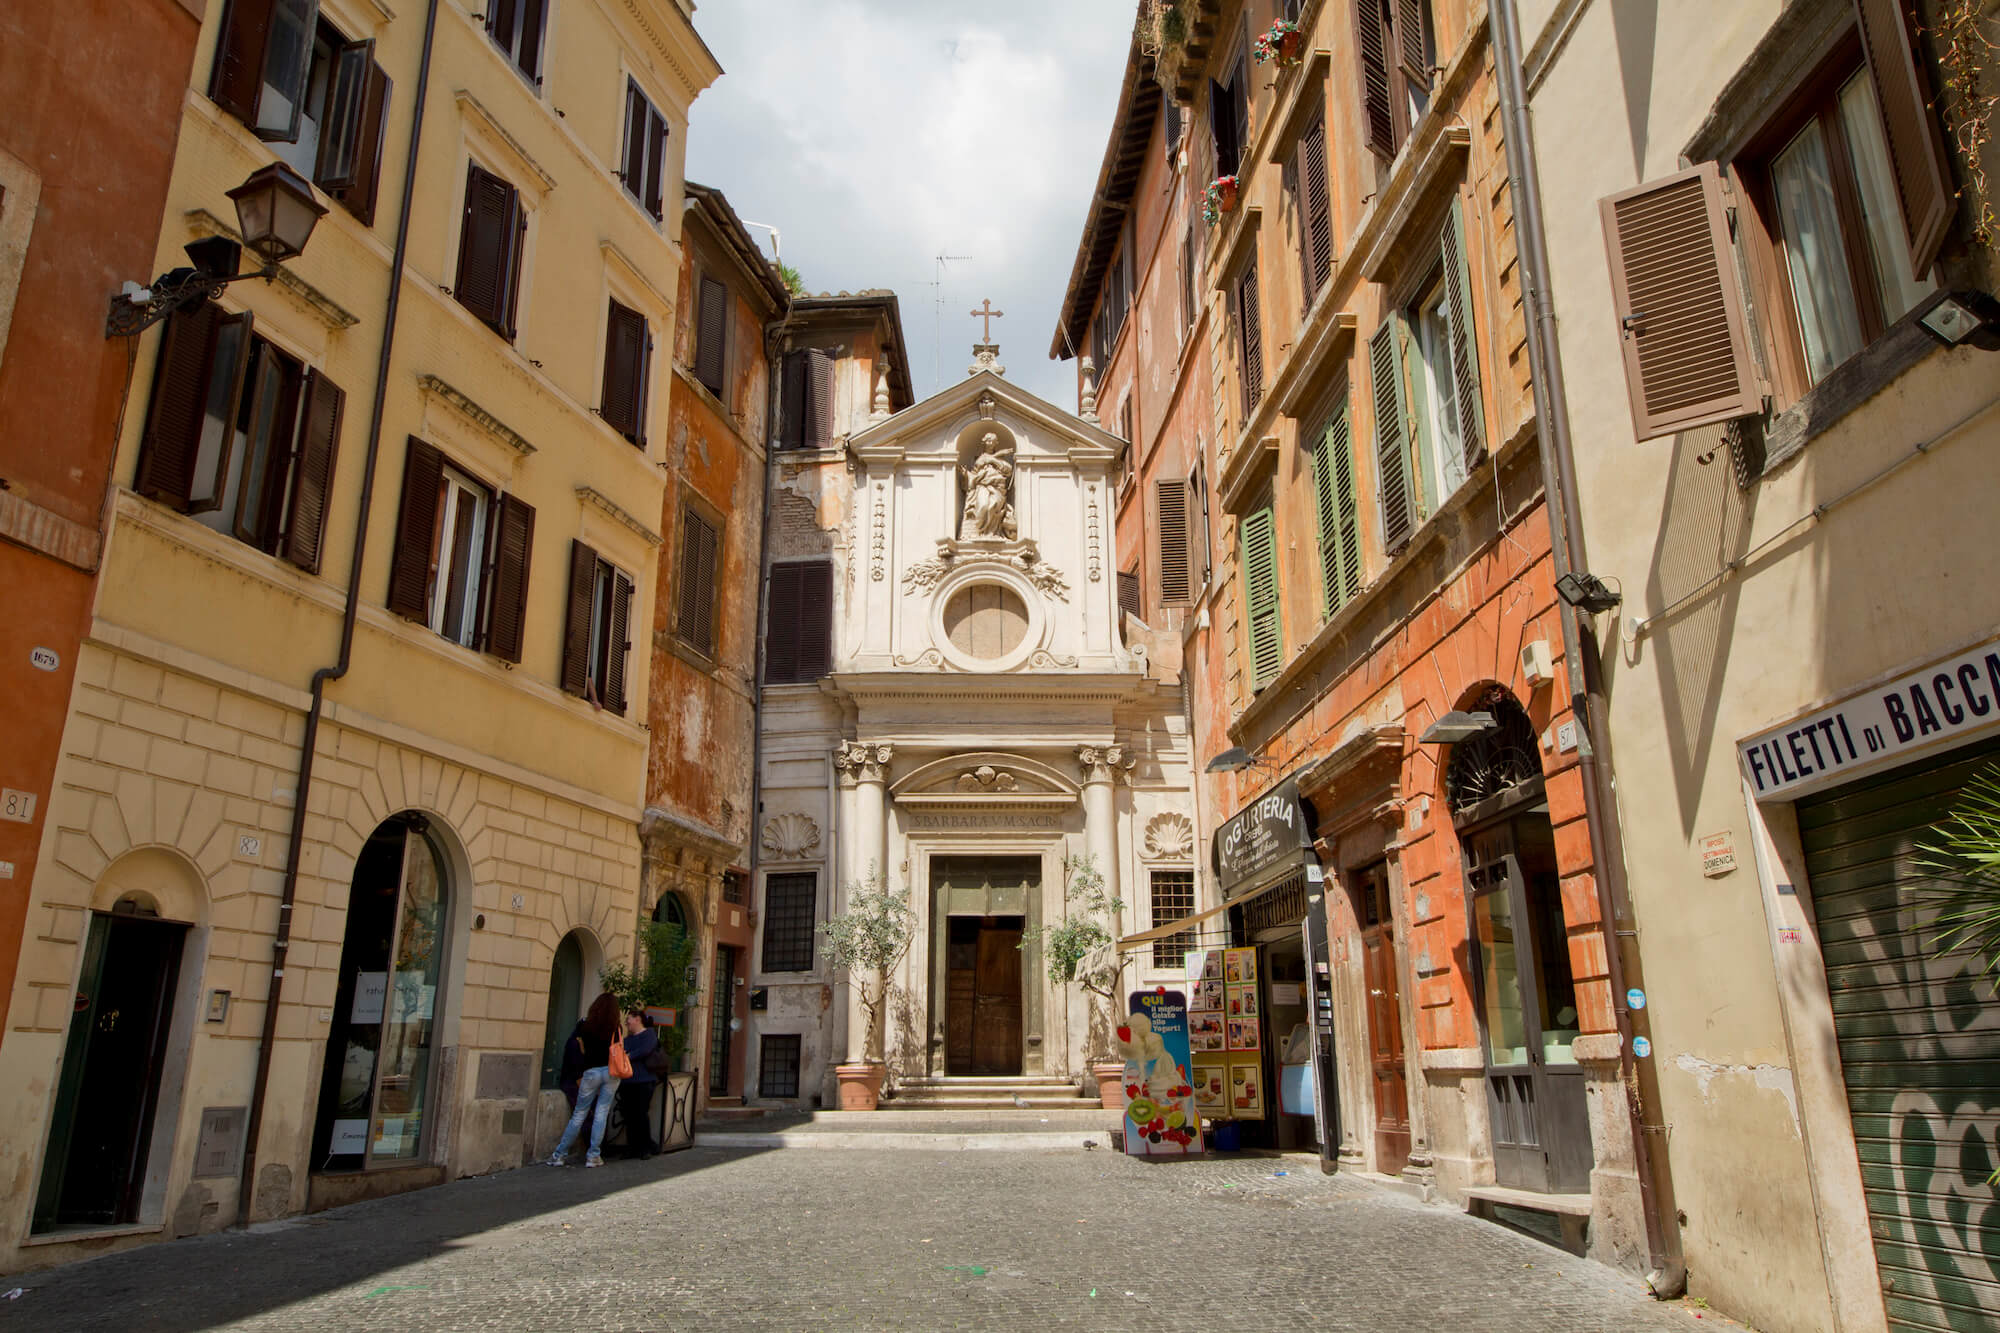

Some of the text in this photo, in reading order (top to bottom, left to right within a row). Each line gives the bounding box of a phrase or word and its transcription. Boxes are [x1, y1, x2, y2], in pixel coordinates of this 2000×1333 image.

[1746, 713, 1858, 791] FILETTI
[1862, 724, 1887, 753] DI
[6, 794, 29, 818] 81
[240, 837, 259, 856] 82
[1703, 854, 1735, 870] DOMENICA
[1141, 995, 1165, 1007] QUI
